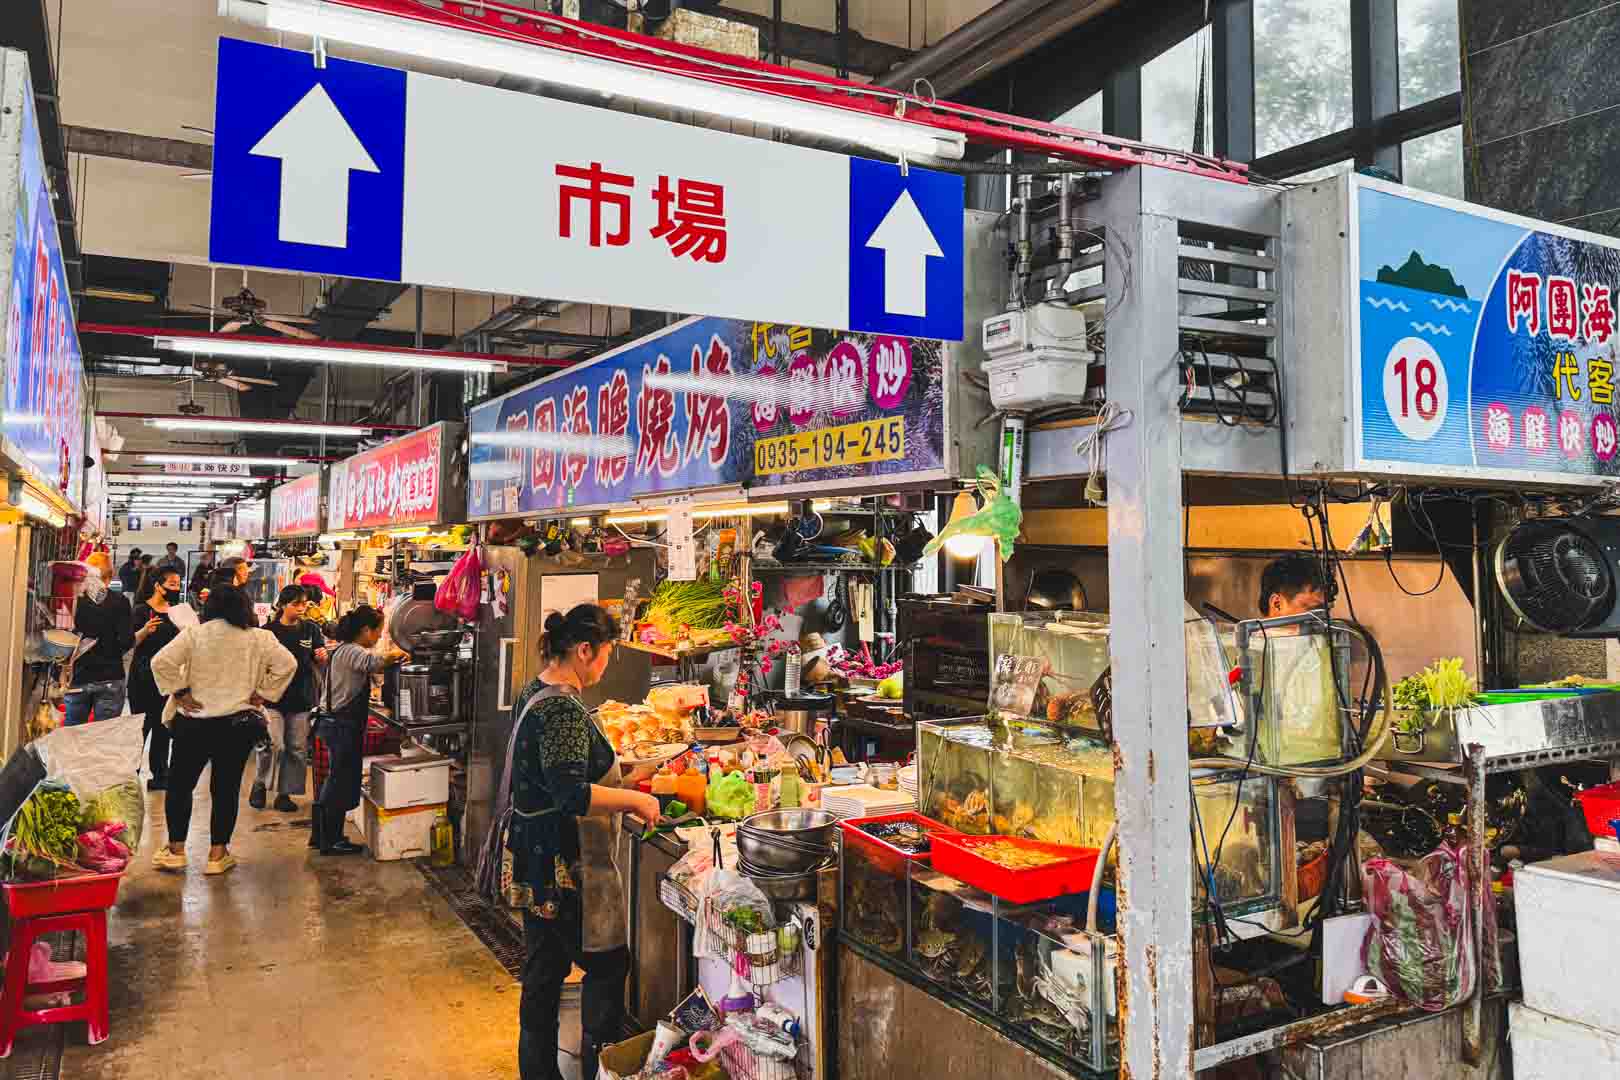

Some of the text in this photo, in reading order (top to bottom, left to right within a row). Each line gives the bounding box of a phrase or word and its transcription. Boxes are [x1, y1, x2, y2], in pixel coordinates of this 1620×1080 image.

[555, 162, 727, 264] 市場
[1393, 356, 1439, 421] 18
[1552, 351, 1615, 404] 代客
[758, 421, 901, 470] 0935-194-245
[1486, 406, 1616, 454] 海鮮快炒
